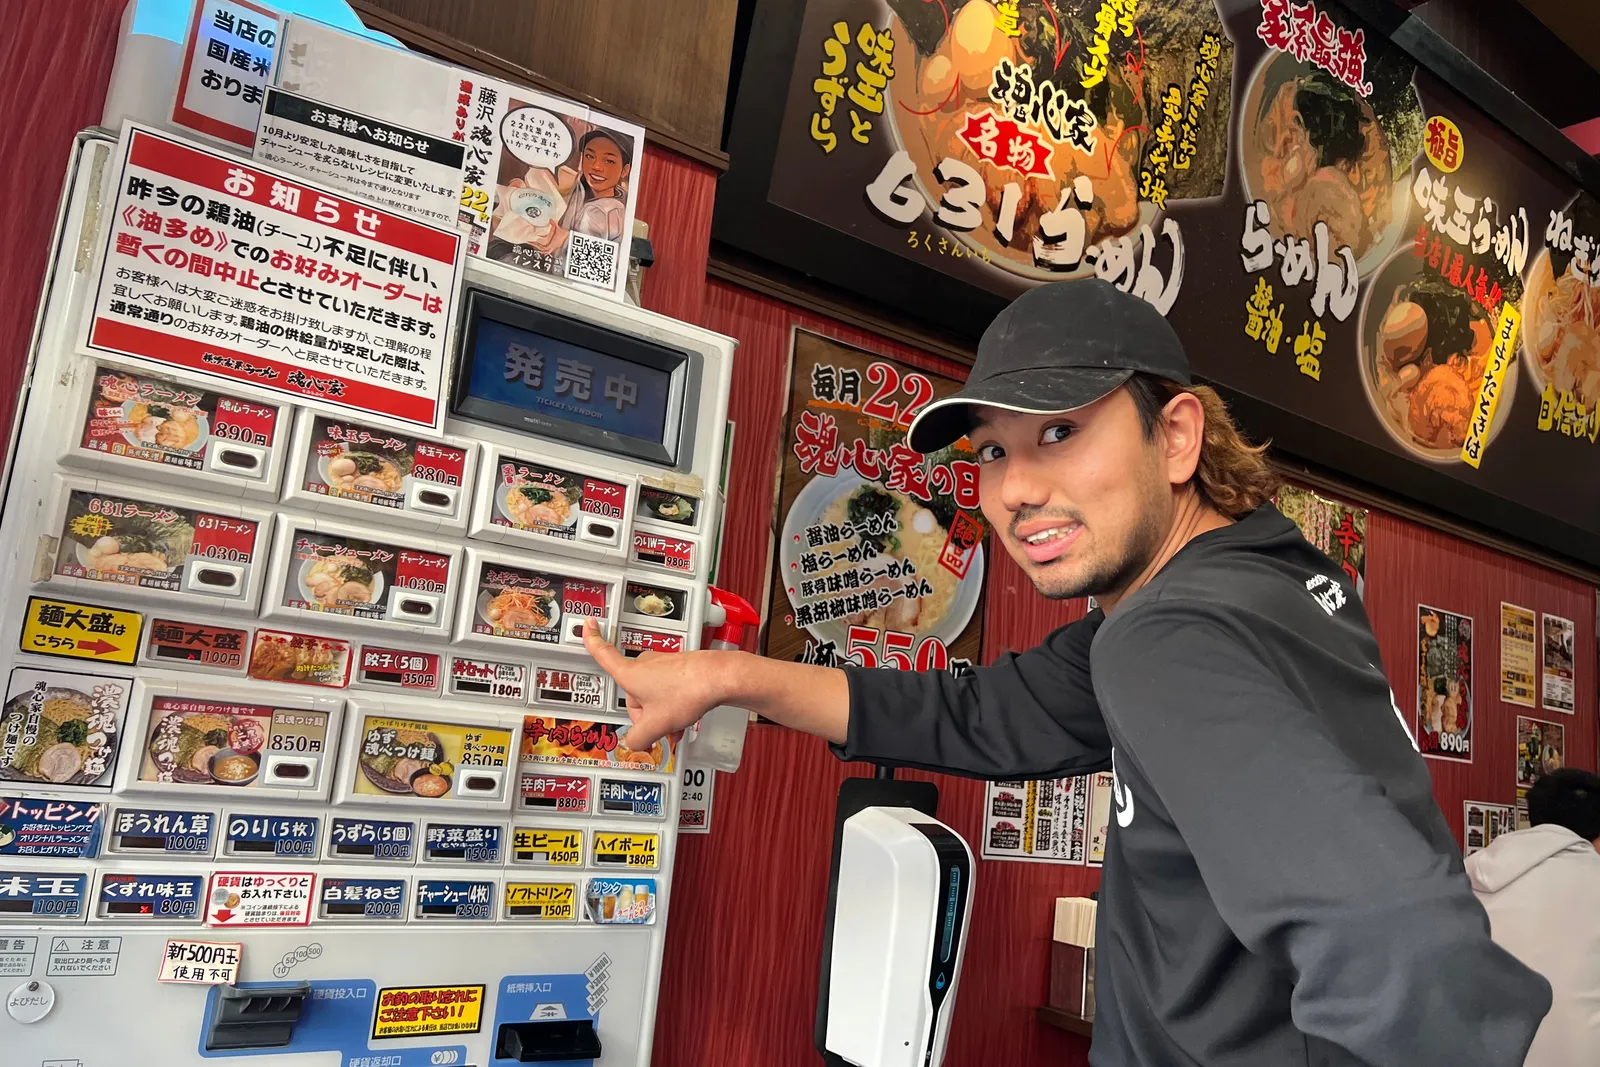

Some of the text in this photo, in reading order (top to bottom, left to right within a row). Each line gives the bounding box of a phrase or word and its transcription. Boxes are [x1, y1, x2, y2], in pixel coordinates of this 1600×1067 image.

[810, 21, 851, 153] うずら
[476, 86, 497, 123] 藤沢
[310, 109, 430, 154] お客様へお知らせ
[511, 129, 558, 149] 記念写真は
[262, 125, 416, 176] 10月より安定した美味しさを目指して
[505, 138, 562, 160] いかがですか
[971, 117, 1036, 170] 名物
[464, 124, 494, 187] 魂心家
[260, 137, 457, 200] チャーシューを炙らないレシピに変更いたします。
[224, 169, 381, 238] お知らせ
[126, 176, 440, 290] 昨今の鶏油(チーユ)不足に伴い、
[906, 231, 993, 264] ろくさんいち
[121, 203, 443, 314] 《油多め》でのお好みオーダーは
[512, 255, 552, 273] インスタ
[115, 231, 438, 341] 暫くの間中止とさせていただきます。
[115, 267, 432, 360] お客様へは大変ご迷惑をお掛け致しますが、ご理解の程
[112, 283, 427, 375] 宜しくお願いします。鶏油の供給量が安定した際は、
[109, 299, 429, 392] 通常通りのお好みオーダーへと戻させていただきます。
[503, 342, 639, 411] 発売中
[100, 375, 202, 406] 魂心ラーメン
[218, 399, 273, 420] 魂心ラーメン
[536, 396, 603, 420] TICKET VENDOR
[215, 422, 268, 447] 890円
[327, 424, 407, 452] 味玉ラーメン
[417, 444, 462, 462] 味玉ラーメン
[414, 464, 459, 486] 880円
[518, 466, 566, 485] ラーメン
[586, 482, 620, 497] ラーメン
[88, 498, 180, 524] 631ラーメン
[583, 498, 621, 518] 780円
[198, 517, 252, 535] 631ラーメン
[805, 512, 898, 547] 醤油らーめん
[296, 537, 395, 563] チャーシューメン
[633, 535, 692, 554] のりWラーメン
[400, 552, 447, 569] チャーシューメン
[666, 555, 691, 568] 980円
[800, 542, 878, 575] 塩らーめん
[486, 572, 551, 588] ネギラーメン
[800, 558, 917, 598] 豚骨味噌らーめん
[565, 581, 602, 595] ネギラーメン
[565, 600, 602, 617] 980円
[795, 578, 934, 629] 黒胡椒味噌らーめん
[38, 604, 126, 636] 麺大盛は
[33, 634, 75, 650] こちら
[153, 624, 241, 650] 麺大盛
[620, 630, 680, 650] 野菜ラーメン
[203, 650, 240, 666] 100円
[365, 652, 429, 672] 餃子(5個)
[453, 660, 493, 679] 丼セット
[403, 673, 434, 686] 350円
[550, 672, 570, 691] 単品
[492, 683, 522, 697] 180円
[573, 692, 601, 705] 350円
[22, 681, 47, 746] 魂心家自慢の
[162, 702, 256, 715] 魂心家自慢のつけ麺です
[275, 714, 325, 728] 濃魂つけ麺
[372, 718, 429, 731] さっぱりゆず風味
[1, 713, 24, 767] つけ麺です
[271, 735, 321, 753] 850円
[367, 730, 396, 744] ゆず
[465, 733, 482, 742] ゆず
[1440, 731, 1470, 753] 890円
[364, 743, 437, 762] 魂心つけ麺
[461, 753, 504, 767] 850円
[521, 777, 587, 793] 辛肉ラーメン
[600, 781, 660, 801] 辛肉トッピング
[558, 797, 587, 809] 880円
[634, 802, 661, 814] 100円
[11, 801, 103, 824] トッピング
[22, 823, 92, 834] お好きなトッピングで
[115, 814, 210, 835] ほうれん草
[229, 818, 315, 838] のり(5枚)
[333, 824, 412, 843] うずら(5個)
[19, 834, 90, 844] オリジナルラーメンを
[168, 836, 207, 850] 100円
[427, 828, 498, 843] 野菜盛り
[514, 833, 579, 850] 生ビール
[593, 836, 655, 853] ハイボール
[18, 846, 84, 855] お召し上がり下さい。
[277, 839, 313, 854] 100円
[377, 844, 409, 858] 100円
[466, 848, 498, 860] 150円
[550, 851, 579, 863] 450円
[628, 854, 655, 866] 380円
[103, 882, 194, 898] くずれ味玉
[218, 876, 309, 888] 硬貨はゆっくりと
[241, 889, 308, 900] お入れ下さい。
[324, 886, 401, 901] 白髪ねぎ
[418, 883, 490, 904] チャーシュー(4枚)
[507, 887, 573, 901] ソフトドリンク
[37, 900, 79, 915] 100円
[160, 899, 196, 914] 80円
[366, 902, 400, 915] 200円
[457, 904, 488, 917] 250円
[544, 904, 571, 917] 150円
[81, 939, 111, 951] 注意
[168, 942, 239, 965] 新500円玉
[52, 964, 111, 972] 入れないでください
[277, 947, 321, 975] 10 50 100 500
[173, 966, 233, 982] 使用不可
[313, 988, 367, 1000] 硬貨投入口
[506, 983, 552, 994] 紙幣挿入口
[9, 996, 49, 1007] よびだし
[349, 1056, 402, 1067] 硬貨返却口
